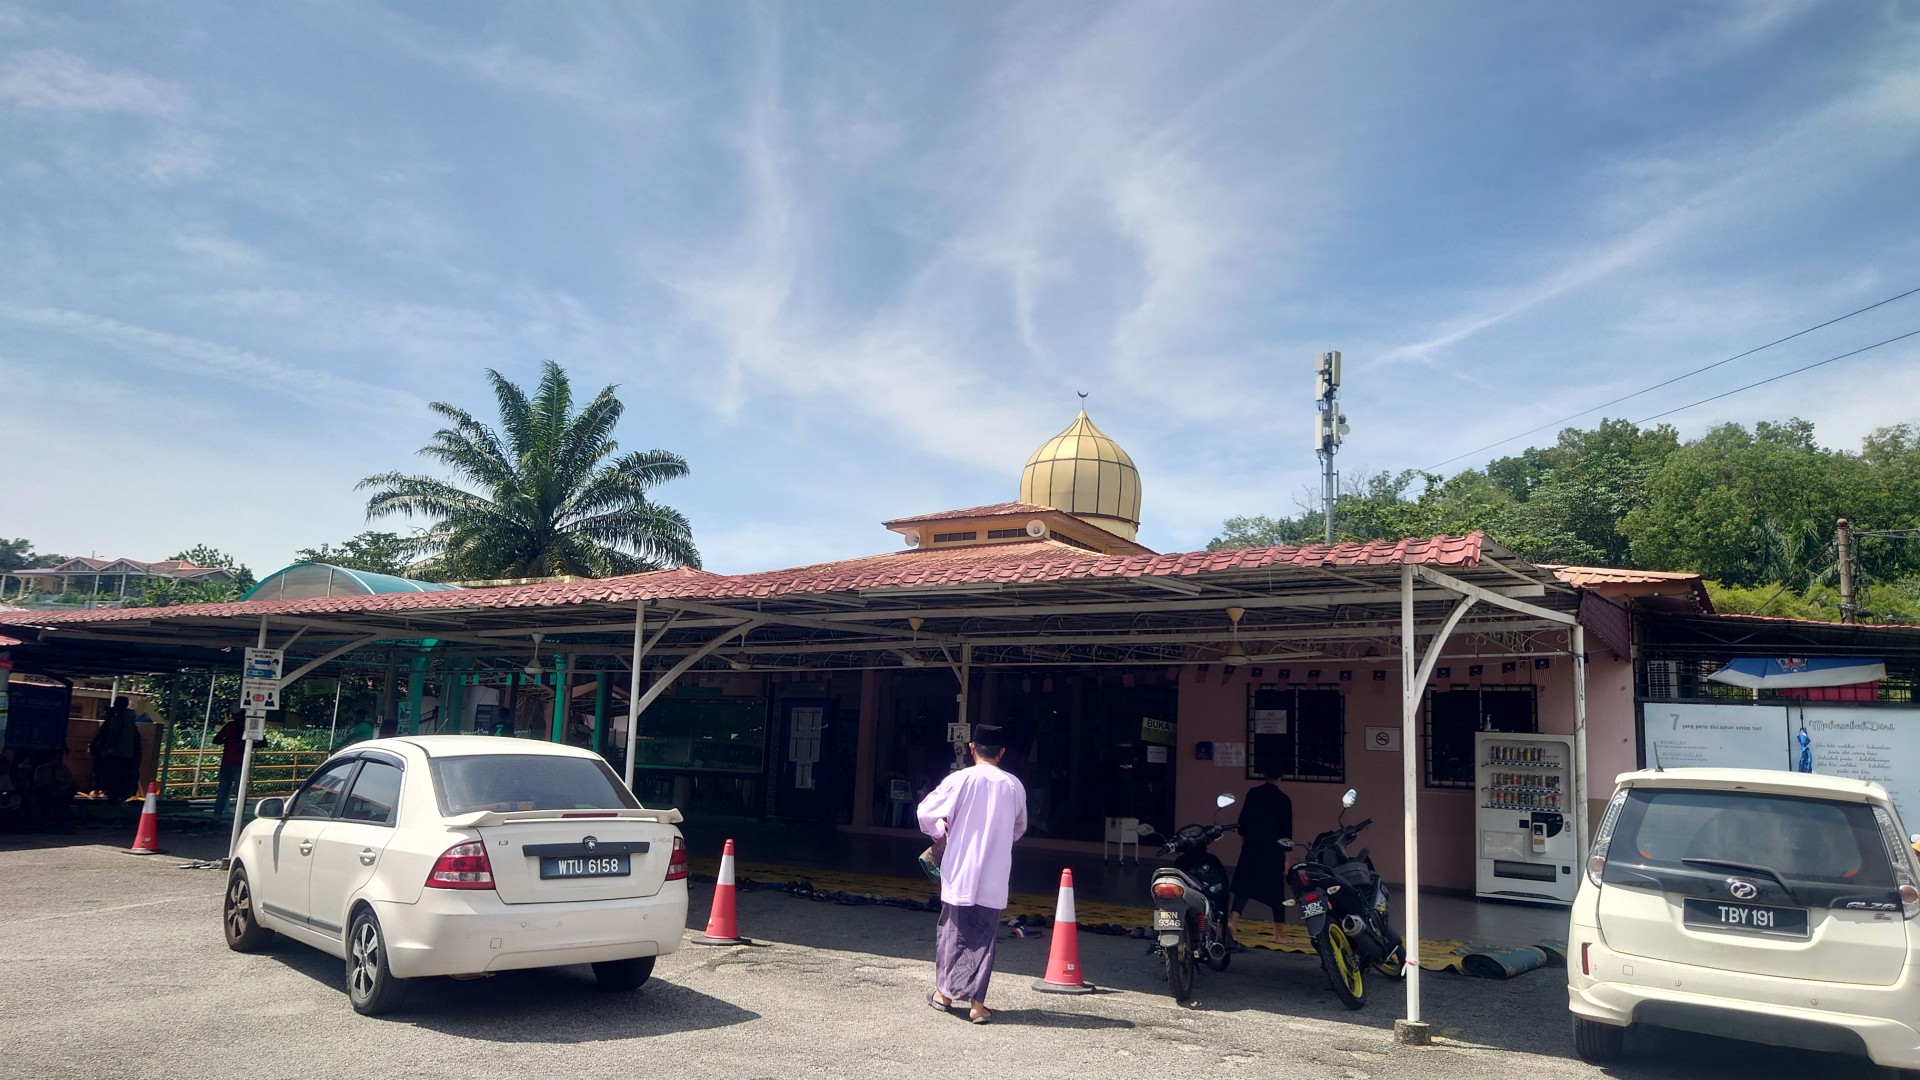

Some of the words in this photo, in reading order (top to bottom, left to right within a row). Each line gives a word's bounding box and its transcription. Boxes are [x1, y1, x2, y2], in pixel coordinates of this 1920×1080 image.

[1147, 719, 1170, 731] BUKA
[1670, 714, 1679, 730] 7
[558, 859, 583, 874] WTU
[588, 858, 619, 873] 6158
[1847, 901, 1896, 911] ALZA
[1158, 919, 1181, 927] 9346
[1718, 906, 1750, 925] TBY
[1752, 910, 1773, 927] 191
